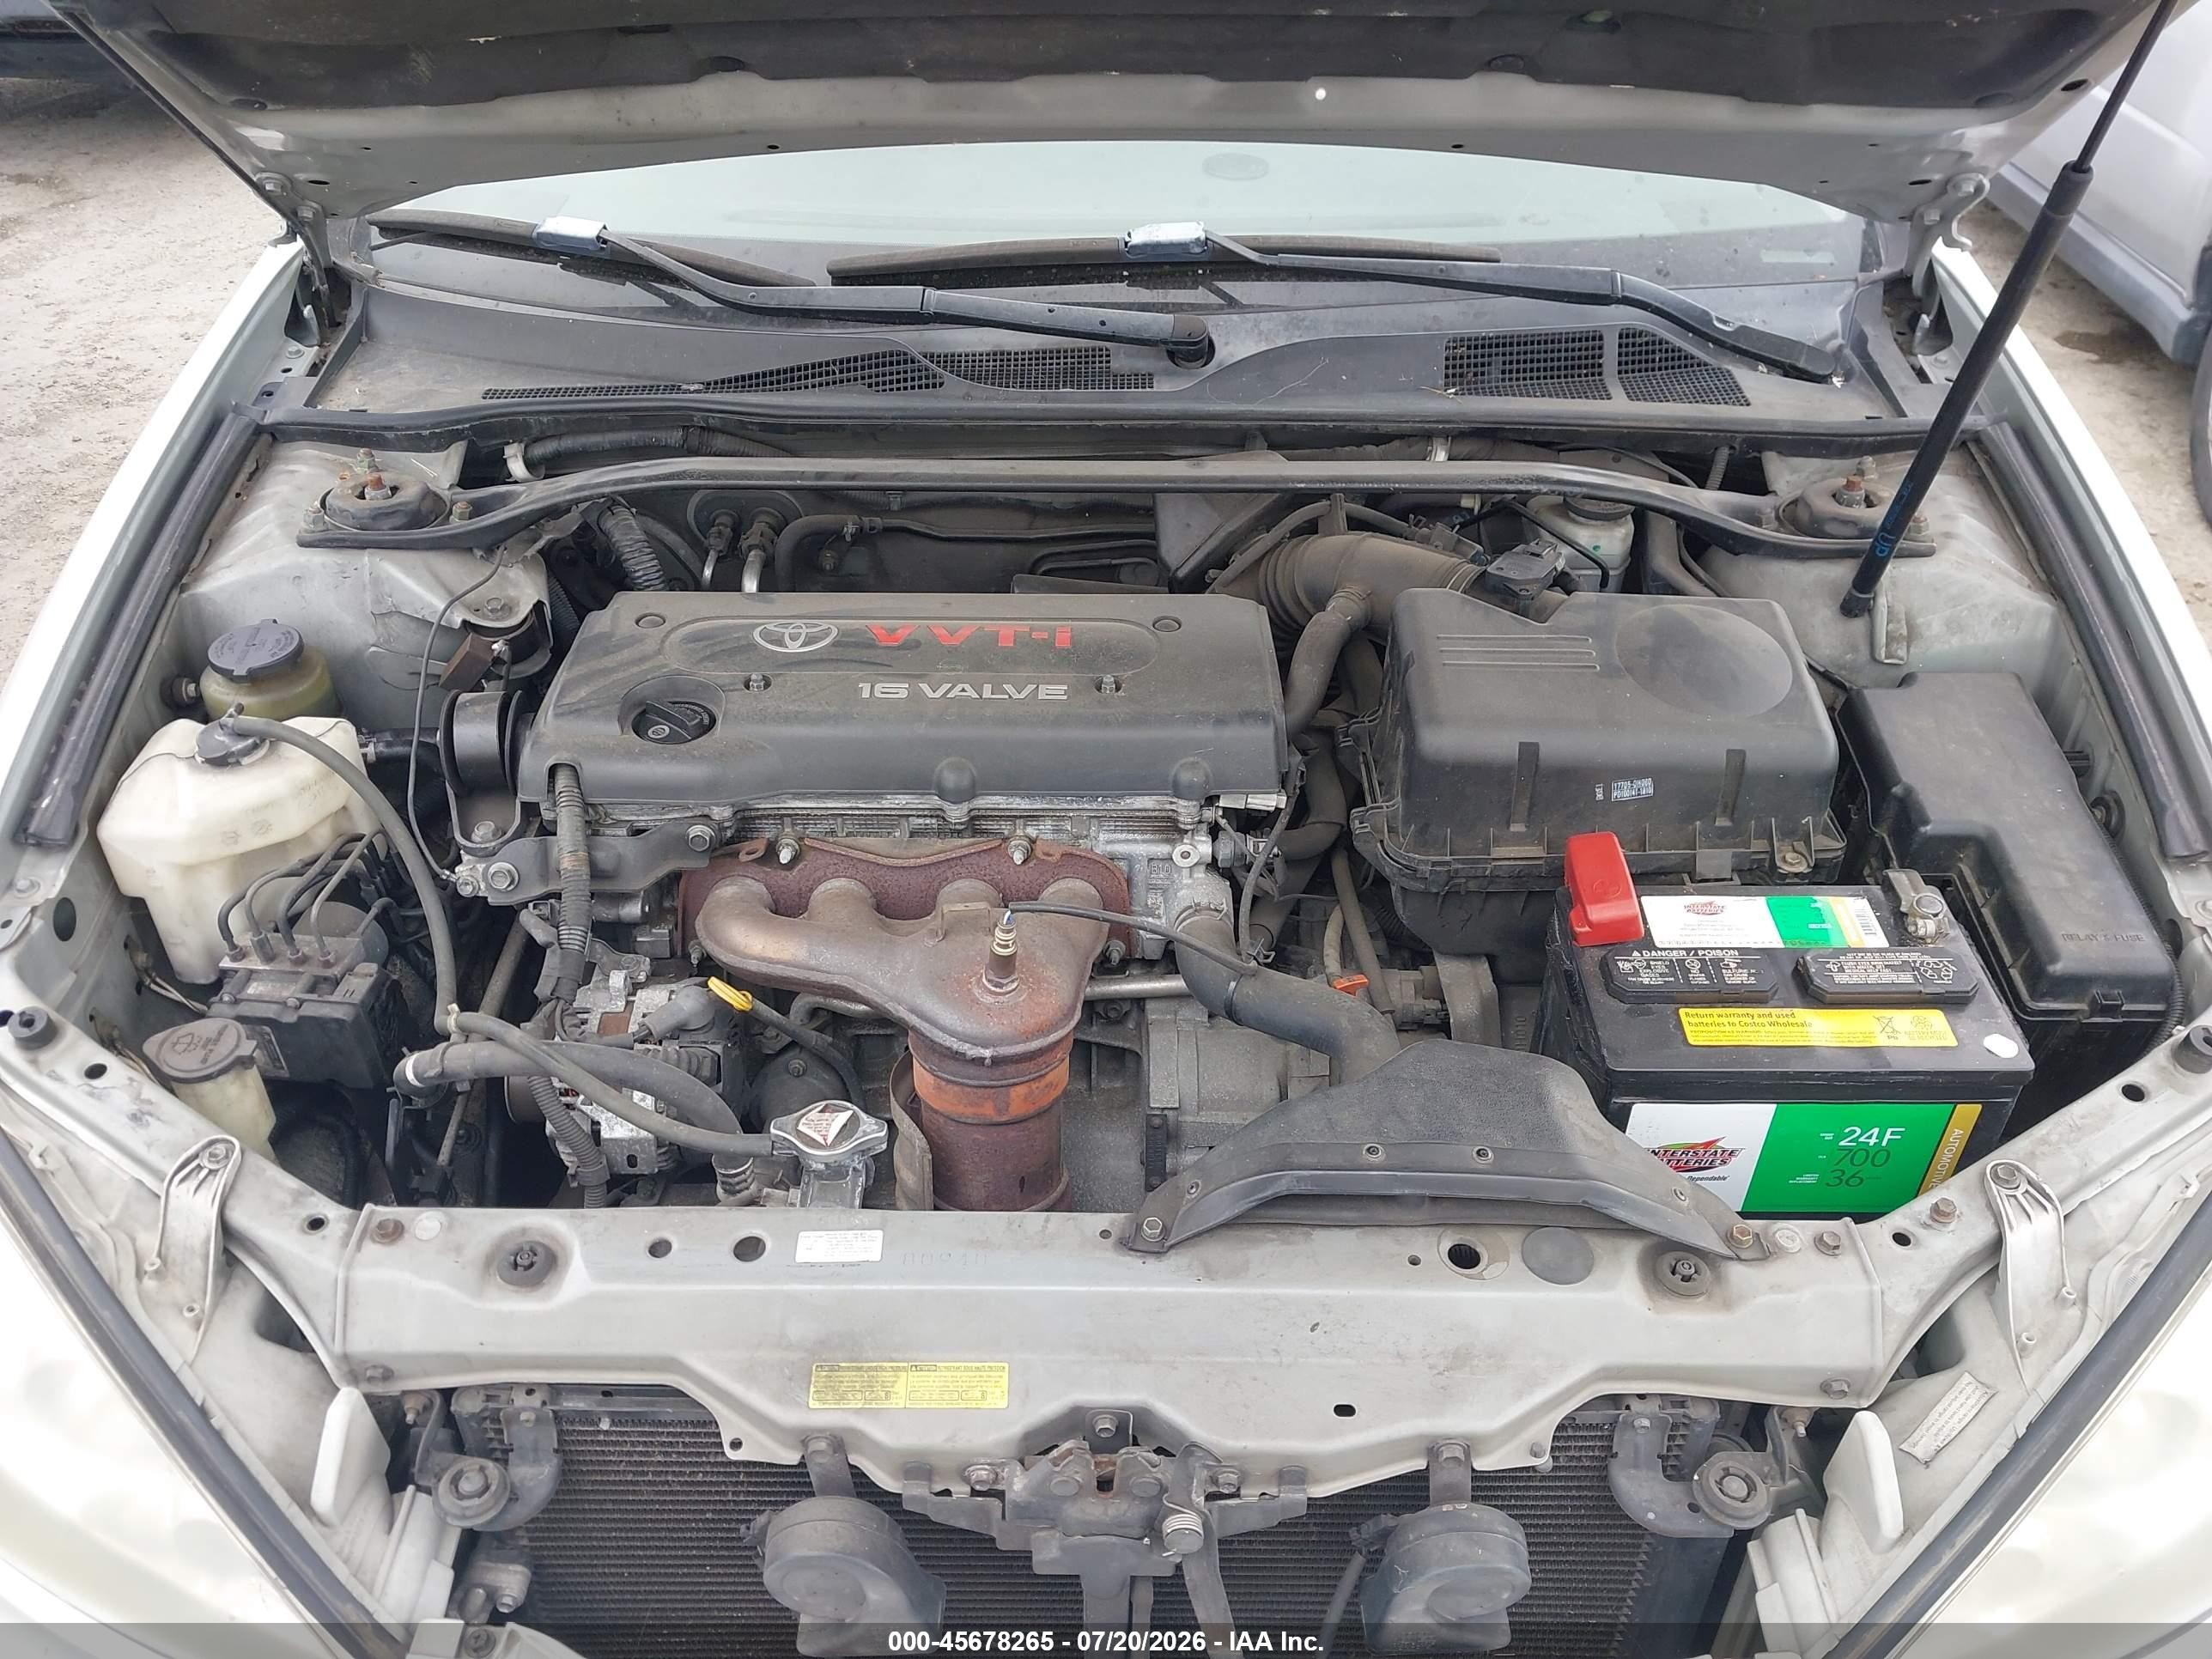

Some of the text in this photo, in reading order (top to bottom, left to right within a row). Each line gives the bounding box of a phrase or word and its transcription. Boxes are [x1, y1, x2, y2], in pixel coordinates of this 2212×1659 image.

[858, 682, 1068, 700] 16 VALVE
[2061, 933, 2100, 942] RELAY
[2113, 933, 2146, 942] FUSE
[1838, 1126, 1905, 1147] 24F
[1648, 1149, 1739, 1158] NTERSTATE
[1661, 1158, 1732, 1166] ATTERIES
[1833, 1148, 1892, 1168] 700
[1825, 1169, 1864, 1188] 36
